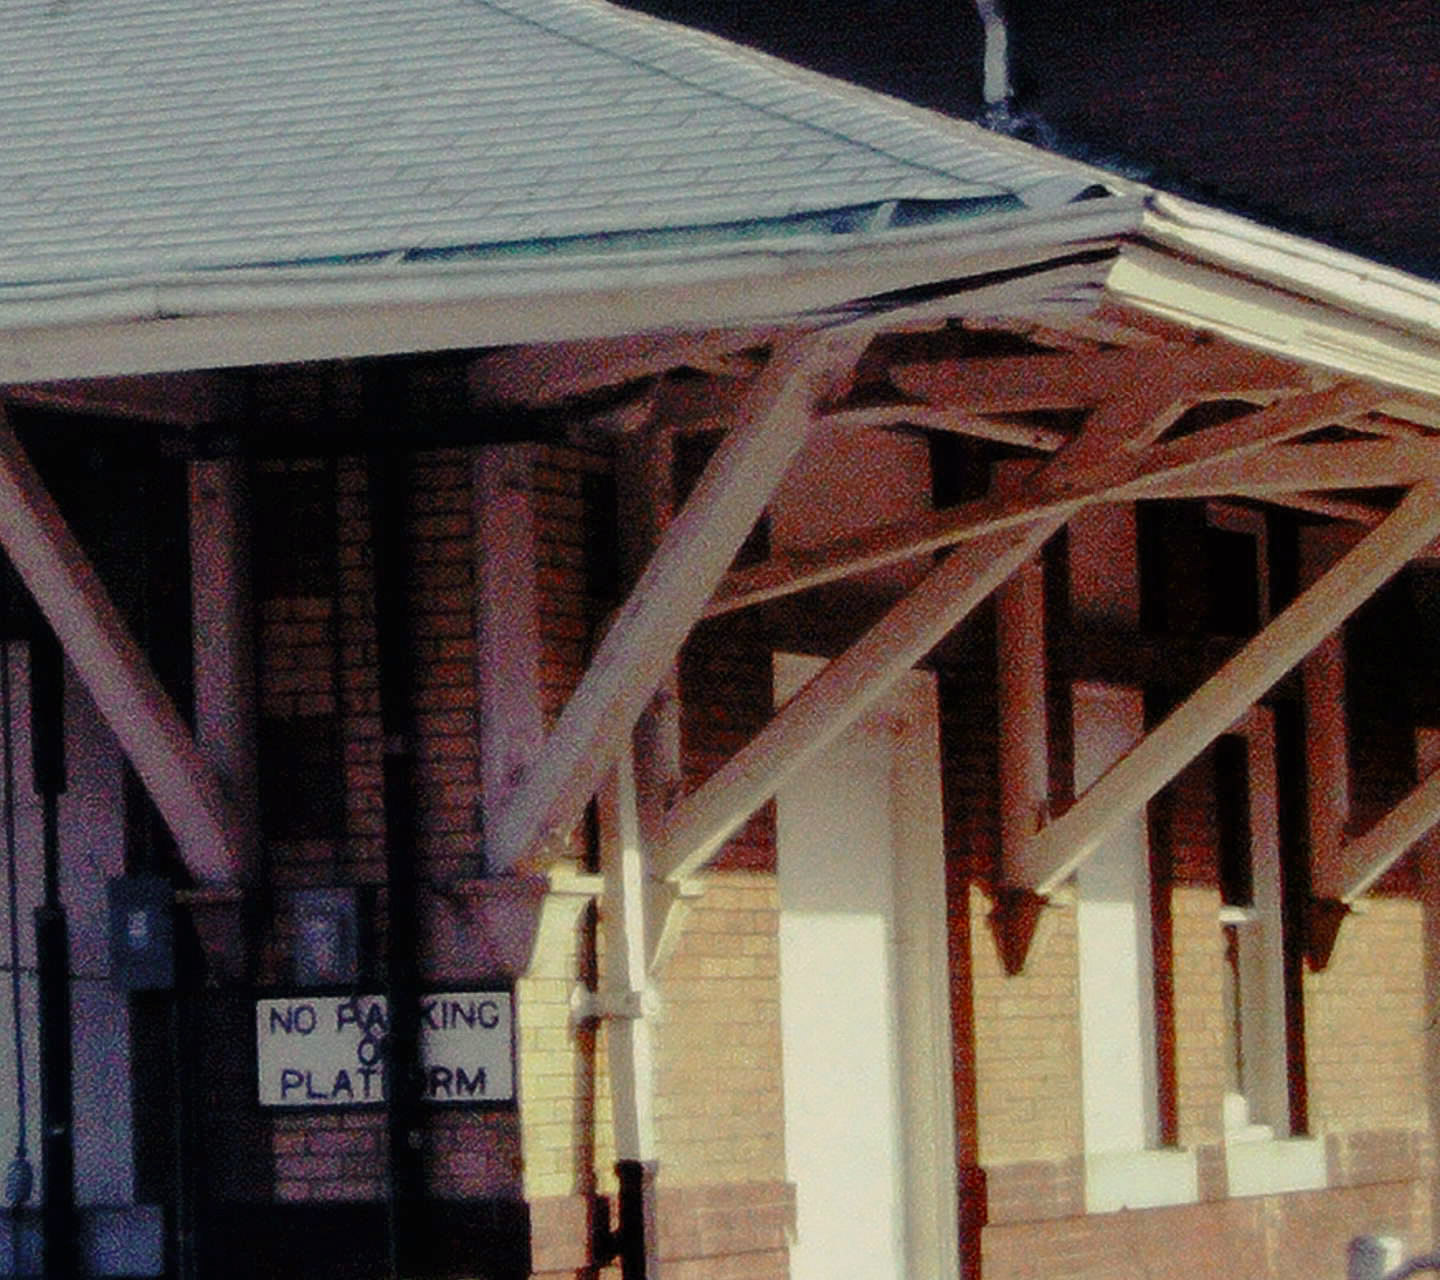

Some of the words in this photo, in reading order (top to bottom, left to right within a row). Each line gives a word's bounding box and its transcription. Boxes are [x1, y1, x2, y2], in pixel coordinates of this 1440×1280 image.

[270, 1004, 318, 1035] NO
[337, 1000, 500, 1033] PAKING
[281, 1066, 488, 1101] PLATRM
